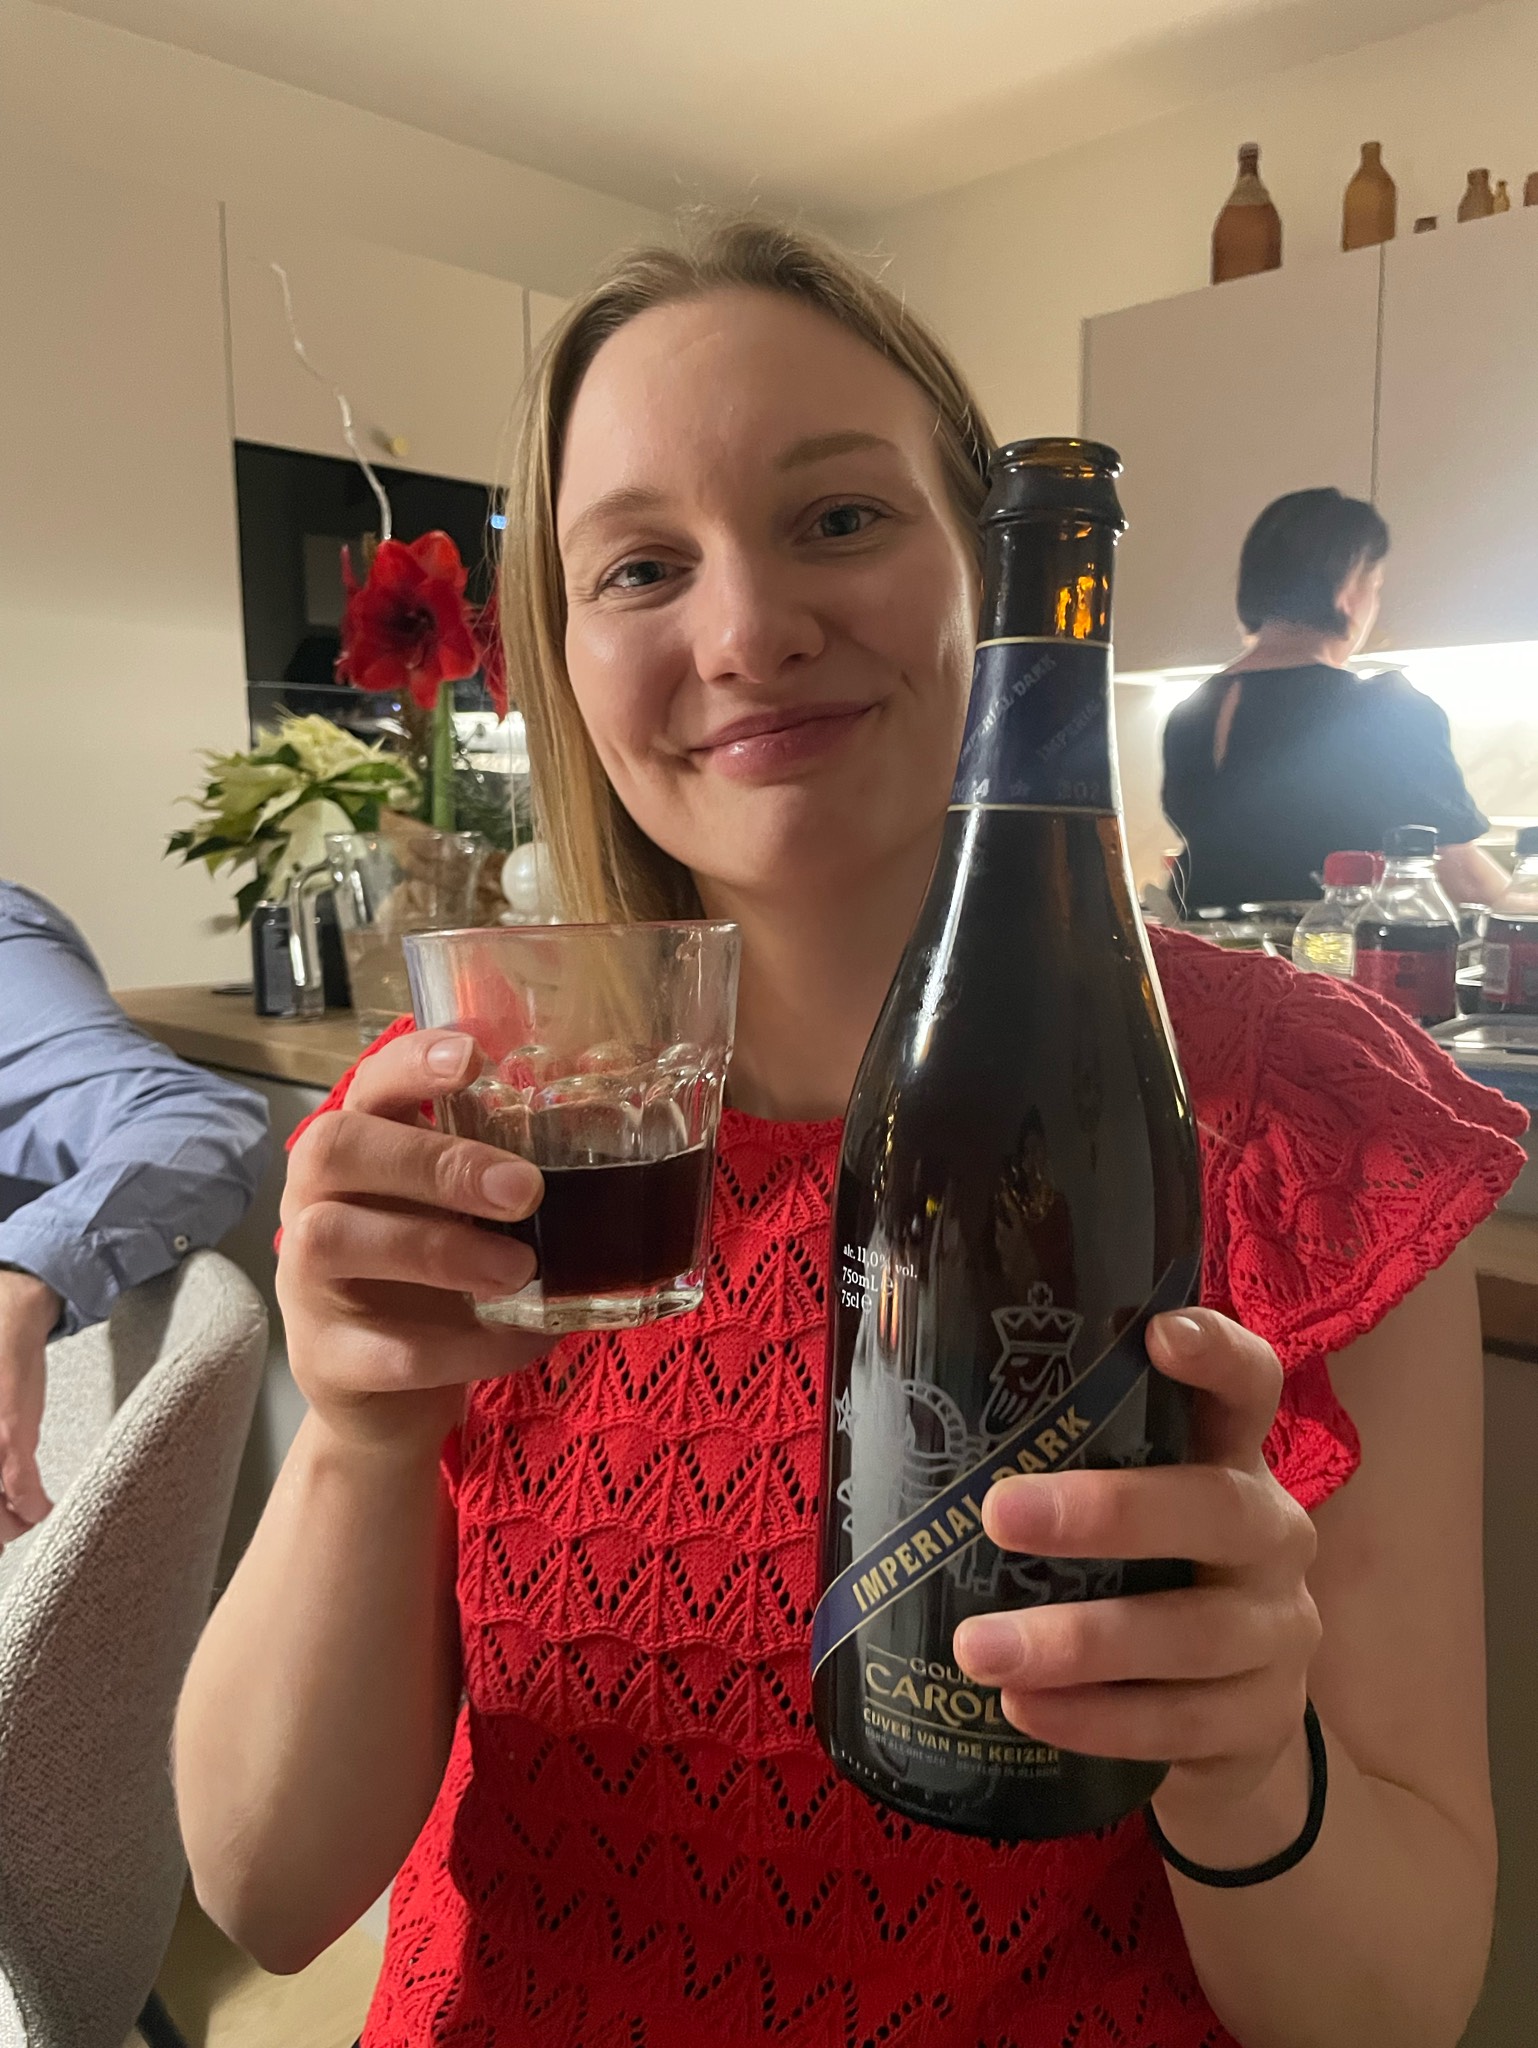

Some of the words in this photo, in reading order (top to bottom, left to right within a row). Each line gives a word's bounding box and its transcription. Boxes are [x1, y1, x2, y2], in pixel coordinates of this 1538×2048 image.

[843, 1243, 856, 1260] alc.
[895, 1263, 918, 1279] vol.
[842, 1265, 879, 1293] 750mL
[841, 1289, 860, 1309] 75cl
[865, 1662, 1000, 1728] CAROL
[917, 1729, 951, 1754] VAN
[957, 1741, 982, 1761] DE
[988, 1744, 1060, 1764] KEIZER
